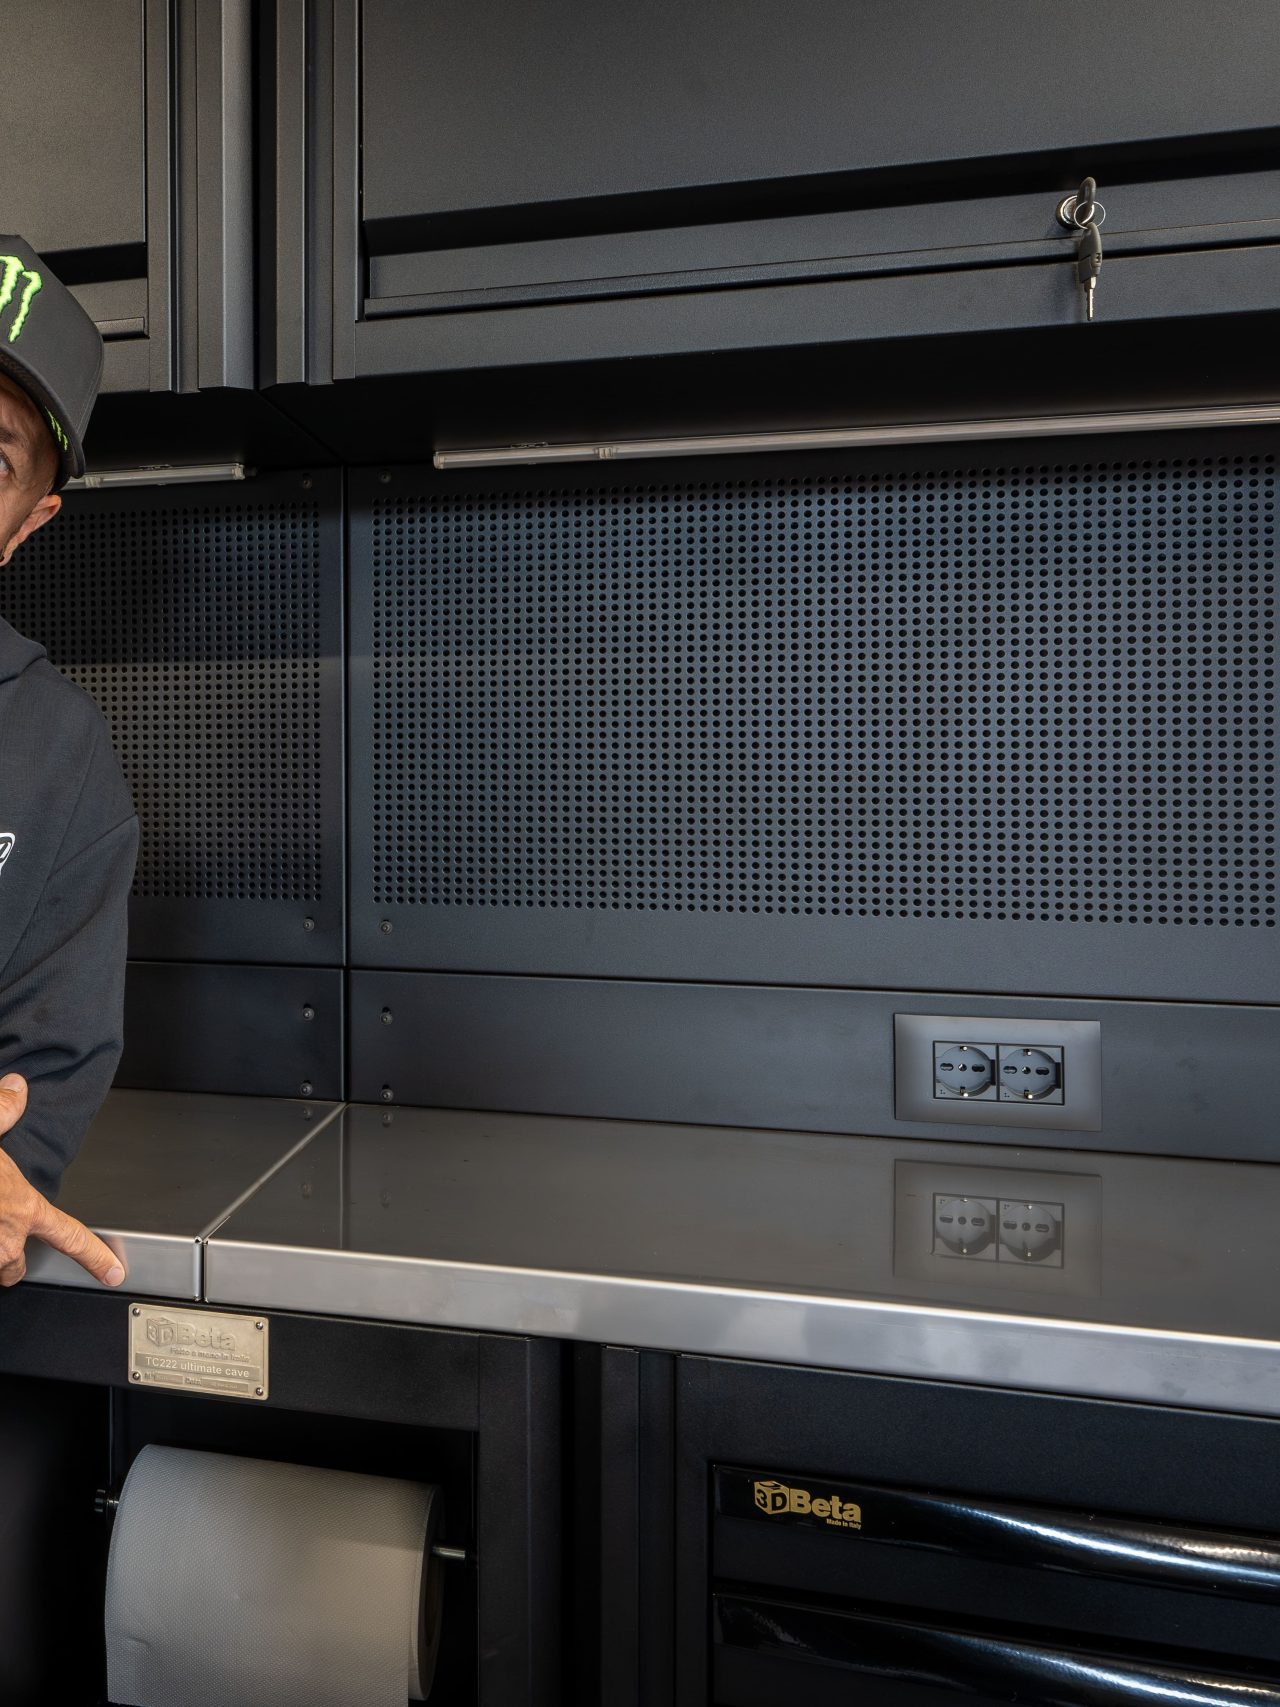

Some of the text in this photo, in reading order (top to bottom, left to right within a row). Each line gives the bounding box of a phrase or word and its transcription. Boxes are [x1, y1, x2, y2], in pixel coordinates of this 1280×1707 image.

[176, 1321, 236, 1351] Beta
[145, 1356, 250, 1378] TC222 ultimate cave
[789, 1488, 862, 1523] Beta
